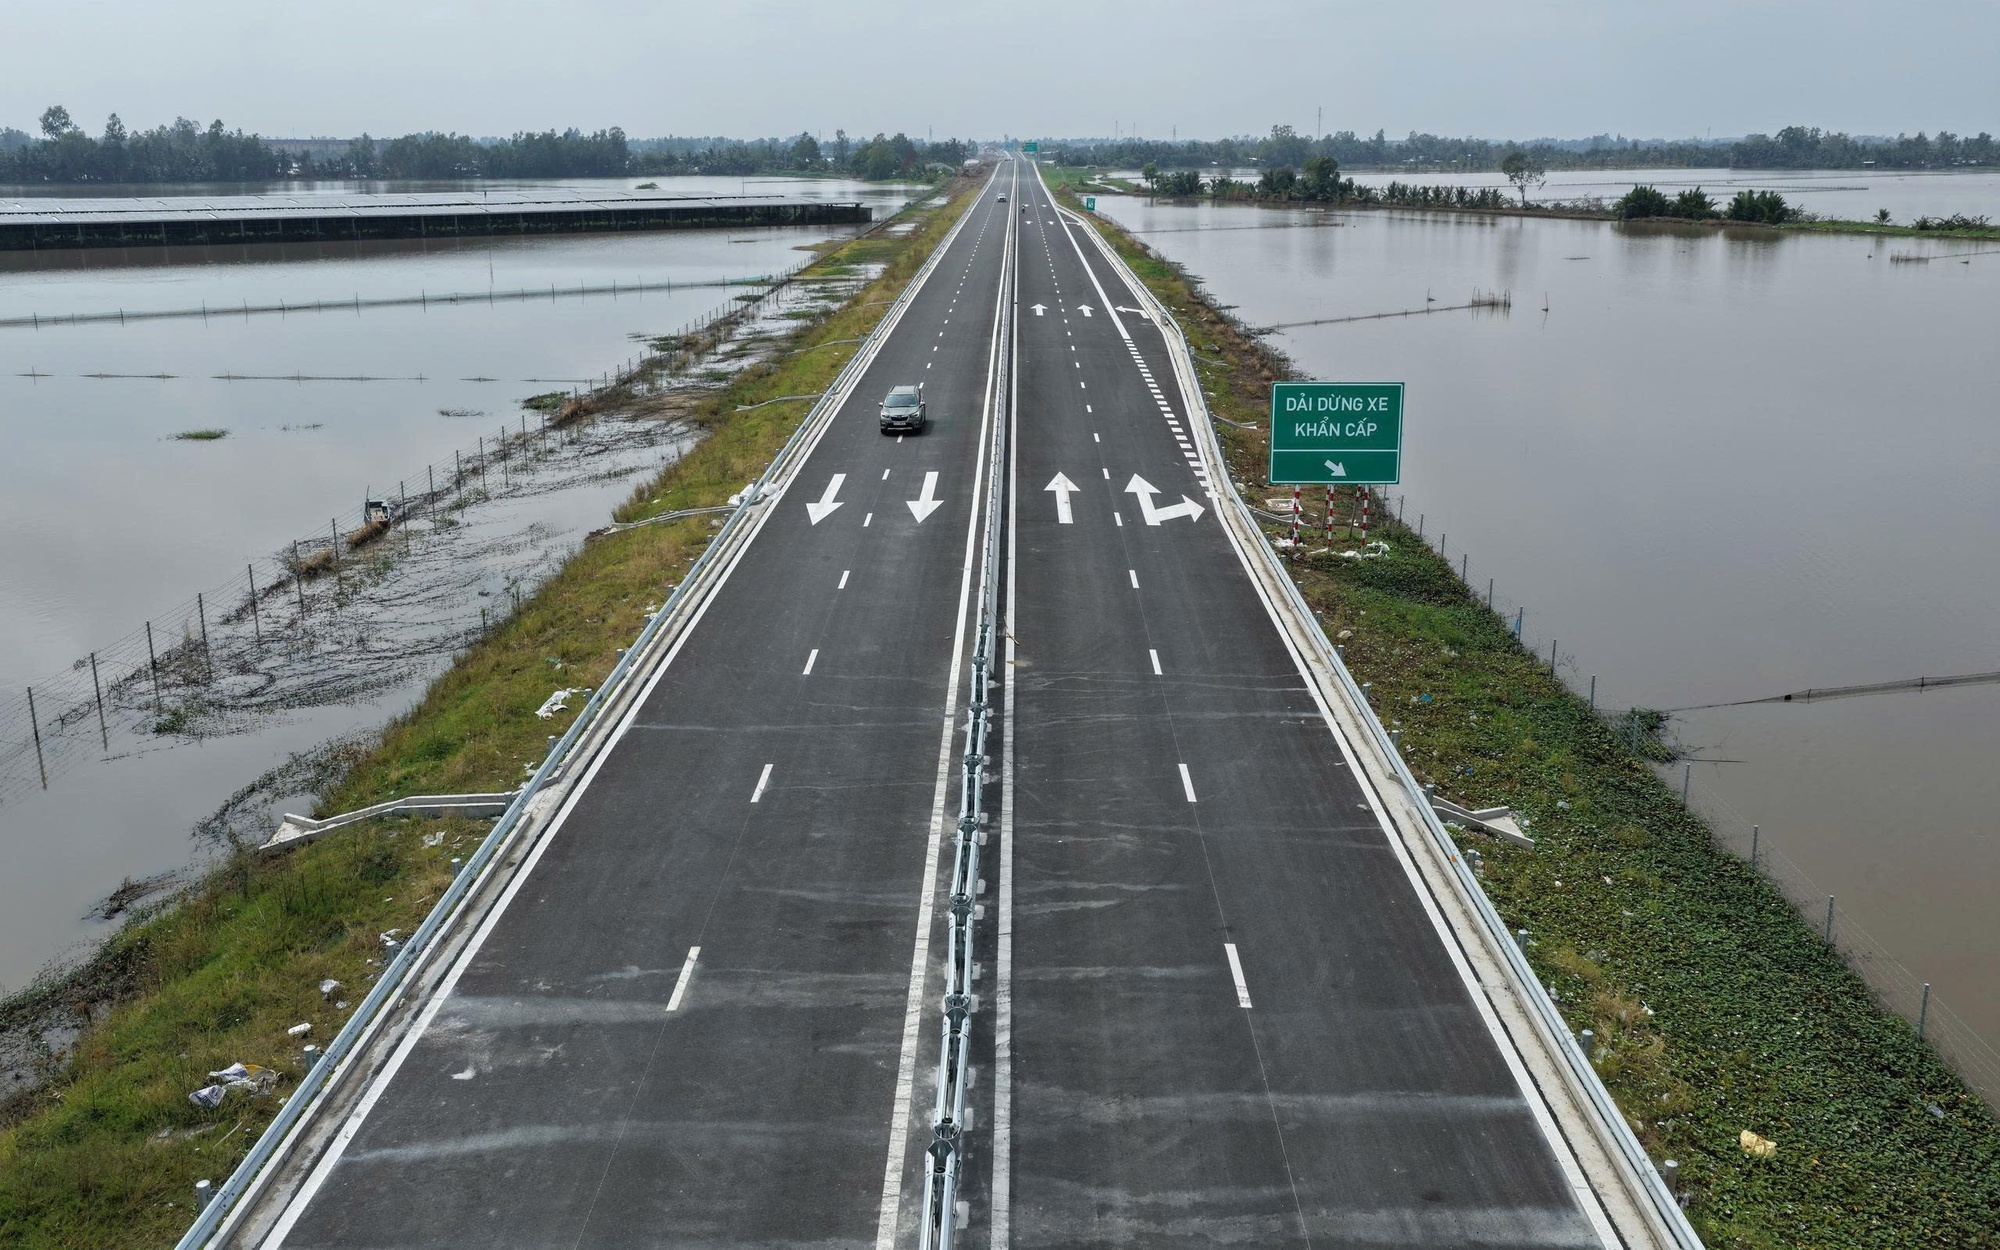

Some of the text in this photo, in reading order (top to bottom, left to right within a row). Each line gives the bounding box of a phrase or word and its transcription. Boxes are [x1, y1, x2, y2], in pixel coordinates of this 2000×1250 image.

[1286, 392, 1389, 411] DẢI DỪNG XE
[1295, 416, 1377, 437] KHẨN CẤP
